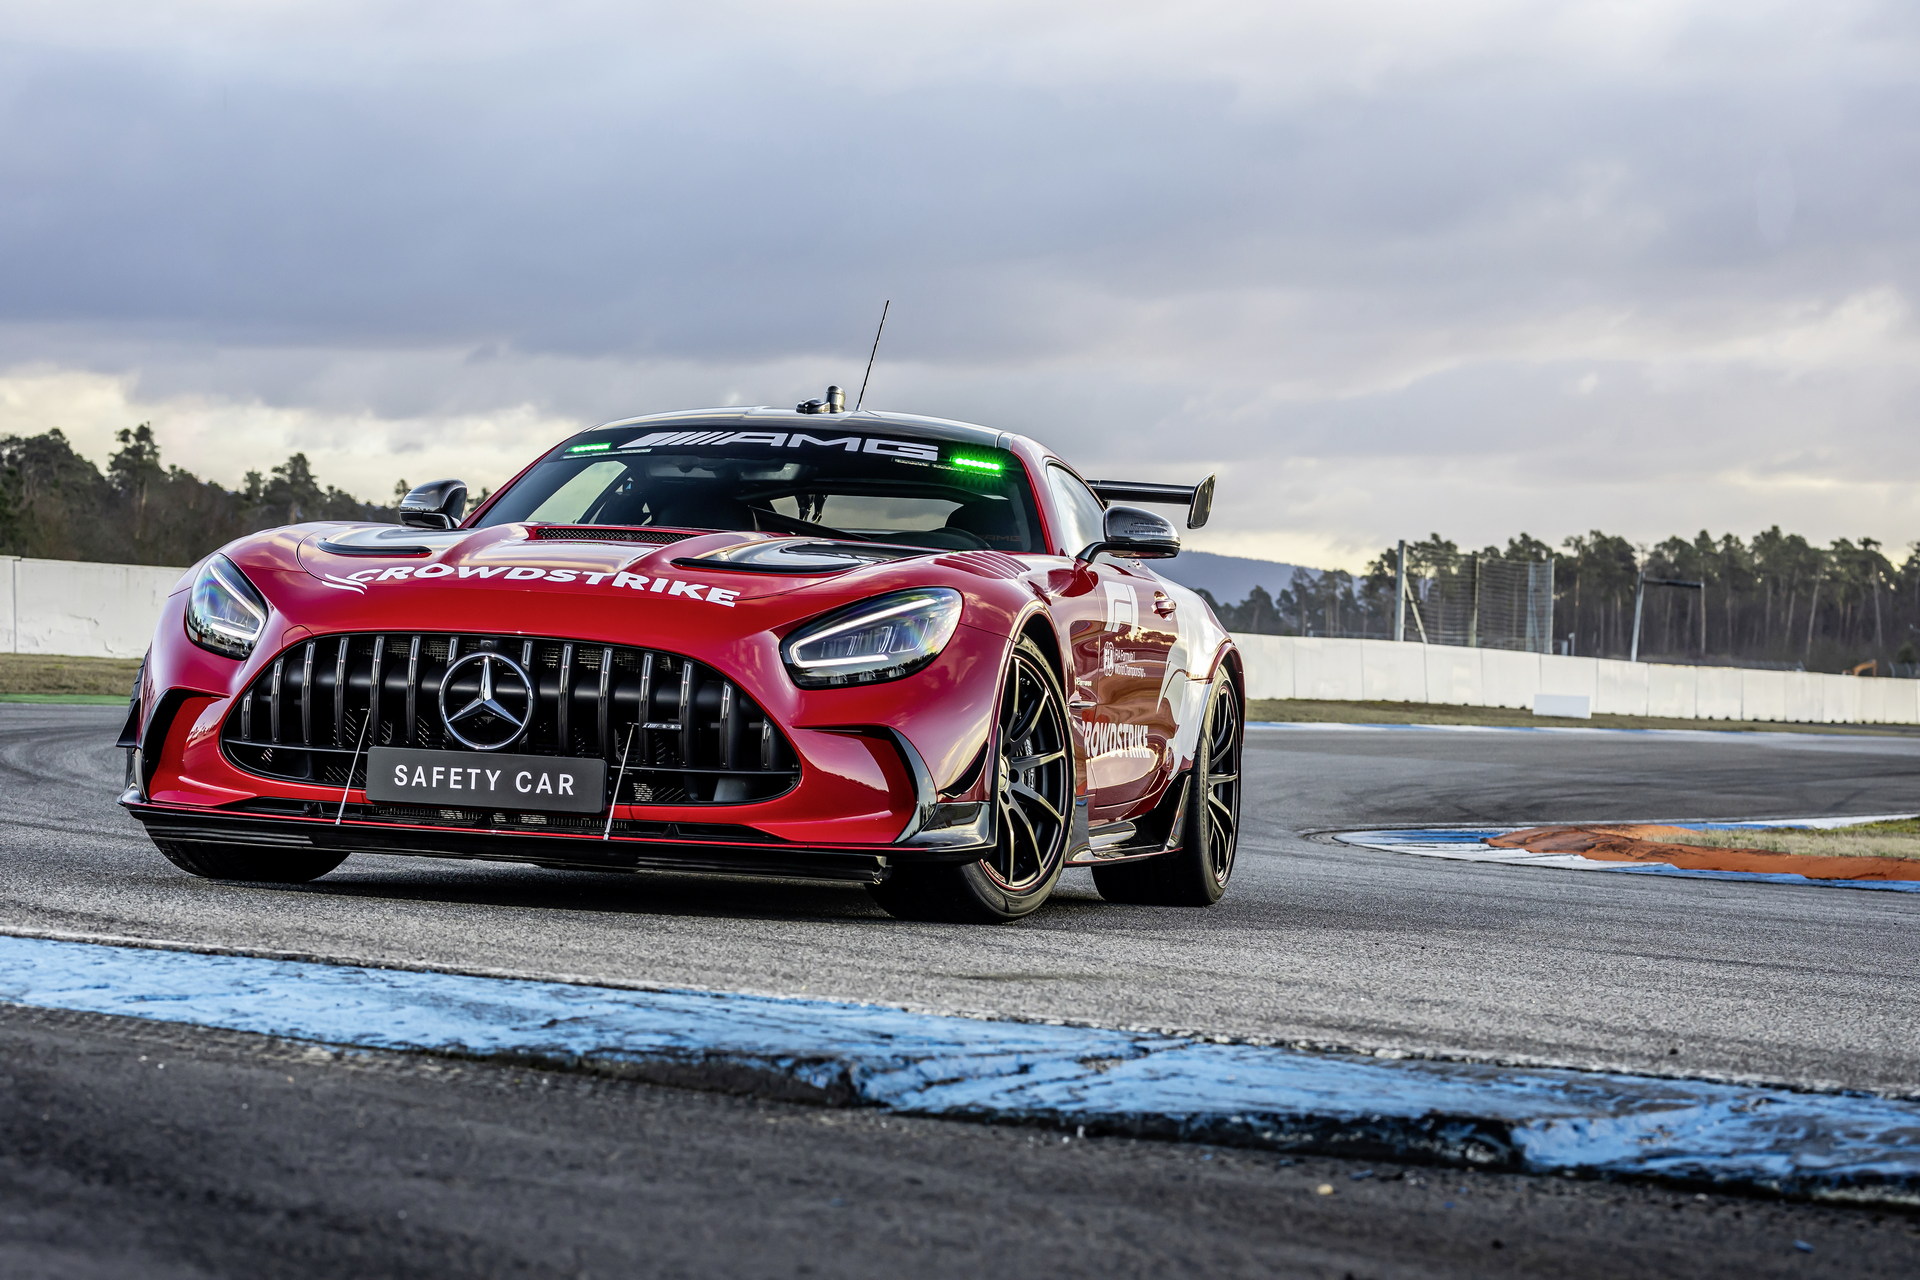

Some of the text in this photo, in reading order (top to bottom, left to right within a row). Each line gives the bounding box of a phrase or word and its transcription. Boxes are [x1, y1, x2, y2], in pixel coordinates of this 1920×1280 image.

[710, 431, 939, 462] AMG
[345, 562, 741, 608] CROWDSTRIKE
[394, 763, 575, 796] SAFETY CAR
